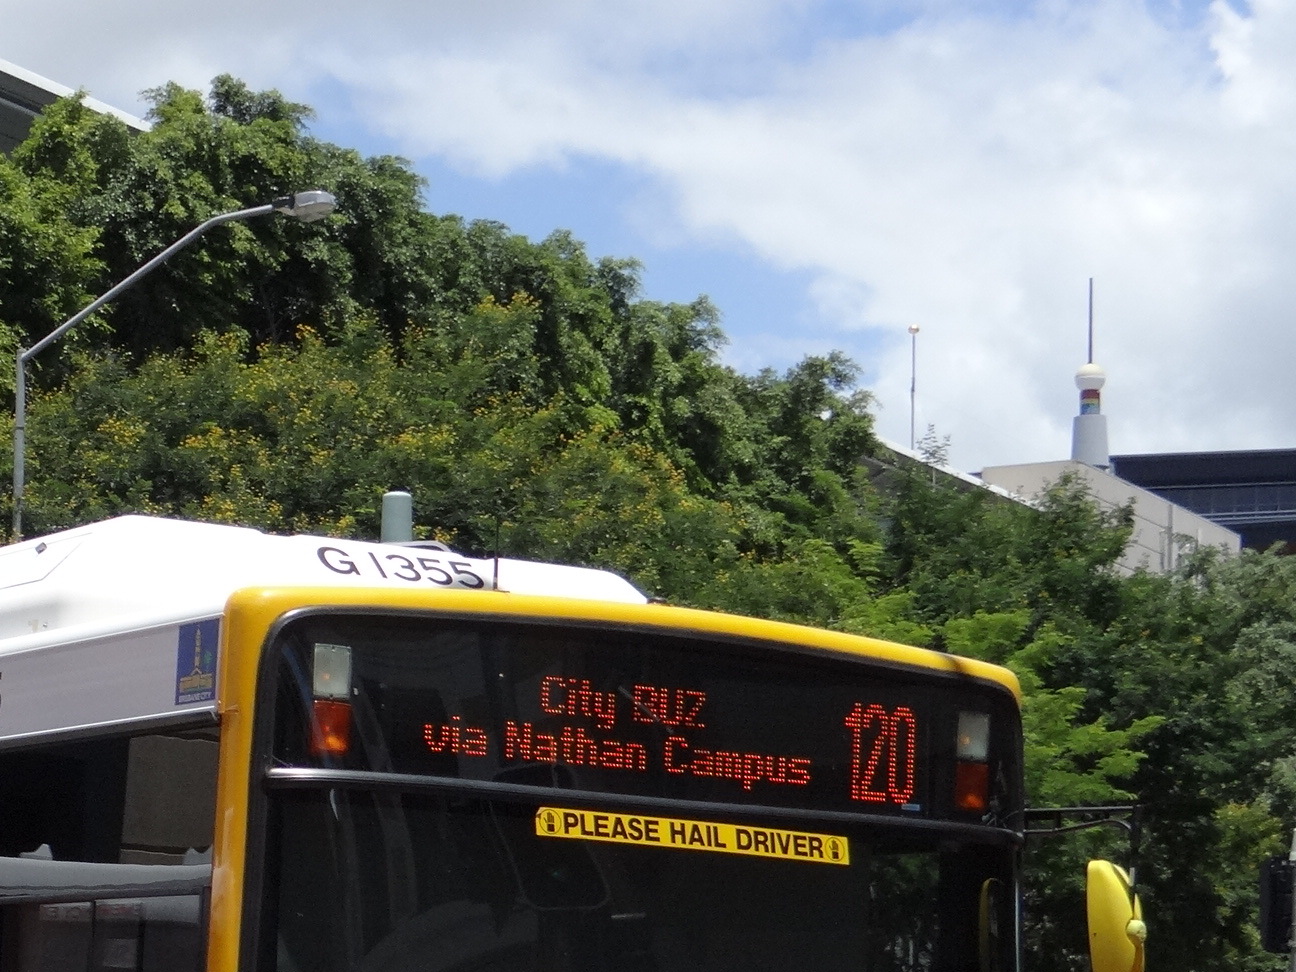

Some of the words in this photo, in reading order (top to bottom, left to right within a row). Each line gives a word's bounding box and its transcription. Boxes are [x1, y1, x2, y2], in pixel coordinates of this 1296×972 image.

[317, 546, 484, 589] G1355
[541, 676, 616, 729] City
[632, 685, 706, 728] BUZ
[423, 716, 489, 757] via
[505, 721, 647, 772] Nathan
[664, 736, 813, 791] Campus
[843, 702, 918, 803] 120
[563, 812, 661, 842] PLEASE
[670, 821, 727, 849] HAIL
[736, 828, 825, 858] DRIVER
